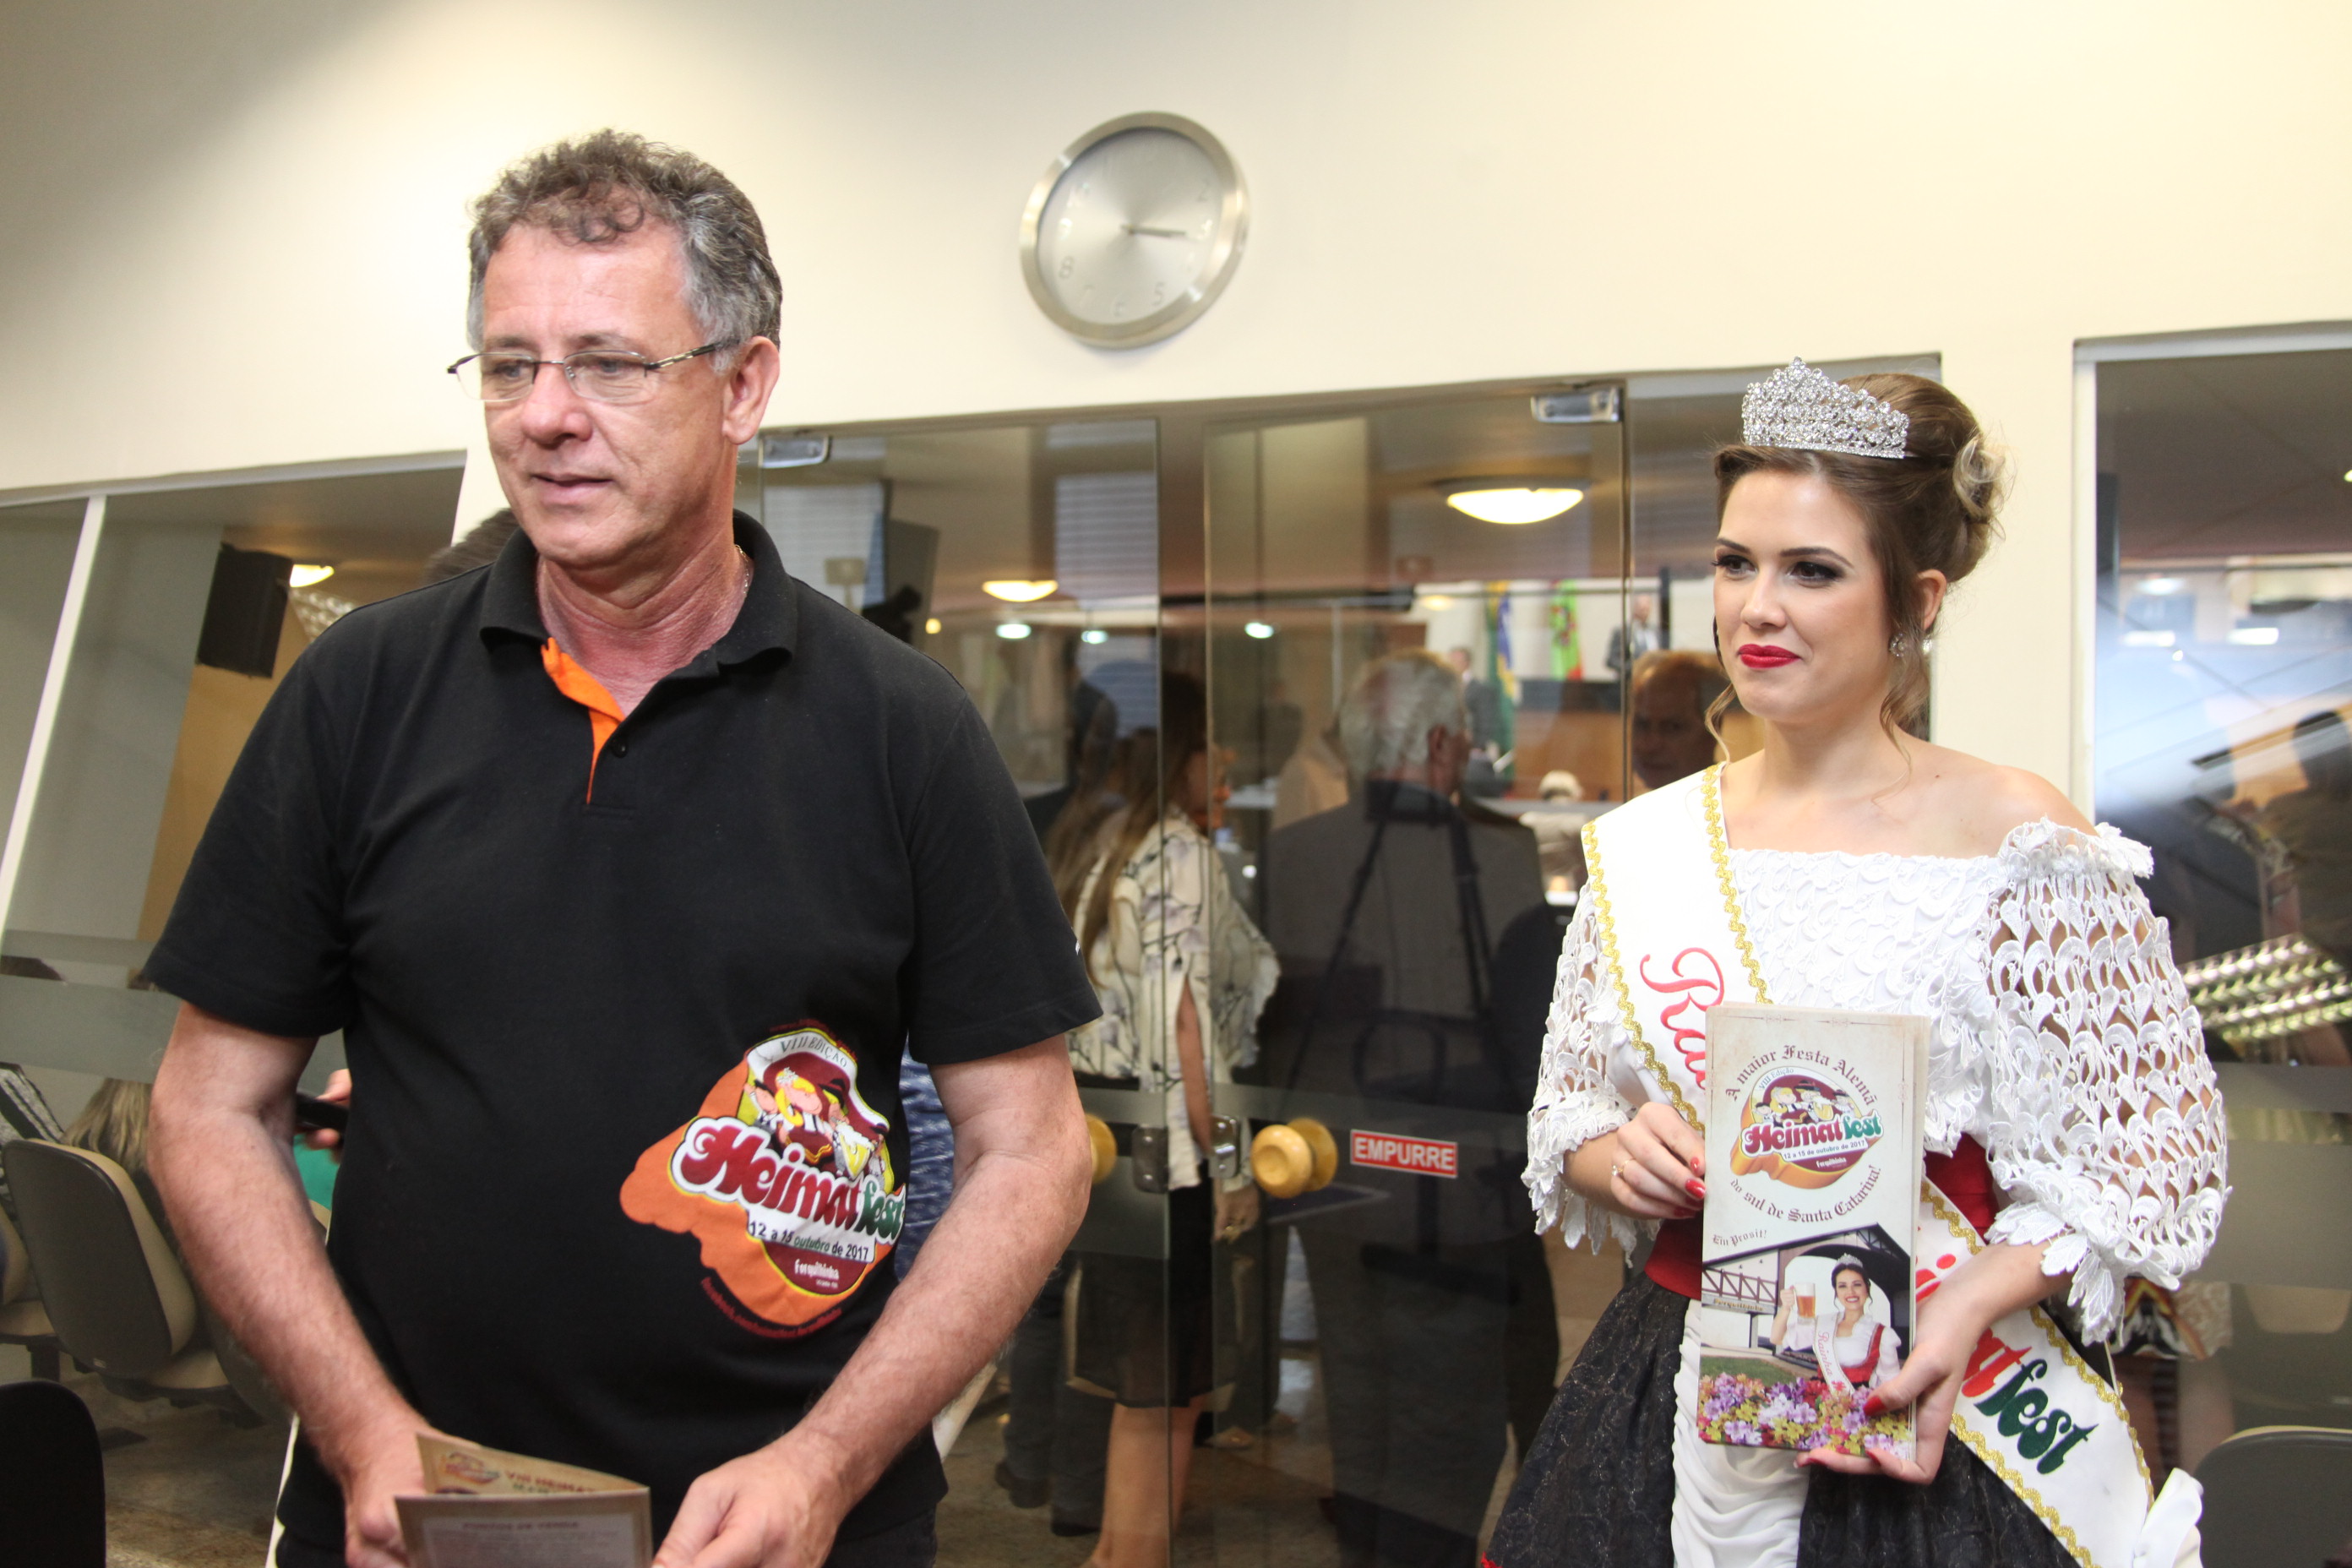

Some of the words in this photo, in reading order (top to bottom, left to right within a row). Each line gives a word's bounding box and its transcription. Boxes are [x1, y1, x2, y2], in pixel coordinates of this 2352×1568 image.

[1737, 1051, 1776, 1085] maior
[1782, 1044, 1830, 1066] Festa
[1832, 1059, 1878, 1105] Alemã
[1354, 1136, 1456, 1171] EMPURRE
[1745, 1113, 1881, 1154] Heimatfest
[1816, 1146, 1840, 1155] outubro
[1850, 1140, 1865, 1148] 2017
[680, 1124, 905, 1240] Heimatfest
[1743, 1192, 1766, 1211] sul
[1767, 1202, 1783, 1219] de
[1788, 1208, 1832, 1223] Santa
[1834, 1164, 1881, 1217] Catarina!
[749, 1221, 766, 1237] 12
[771, 1229, 778, 1240] a
[781, 1229, 795, 1244] 15
[794, 1235, 830, 1252] outubro
[831, 1241, 844, 1255] de
[846, 1243, 869, 1261] 2017
[1712, 1234, 1729, 1246] Ein
[1730, 1228, 1767, 1247] Prosit!
